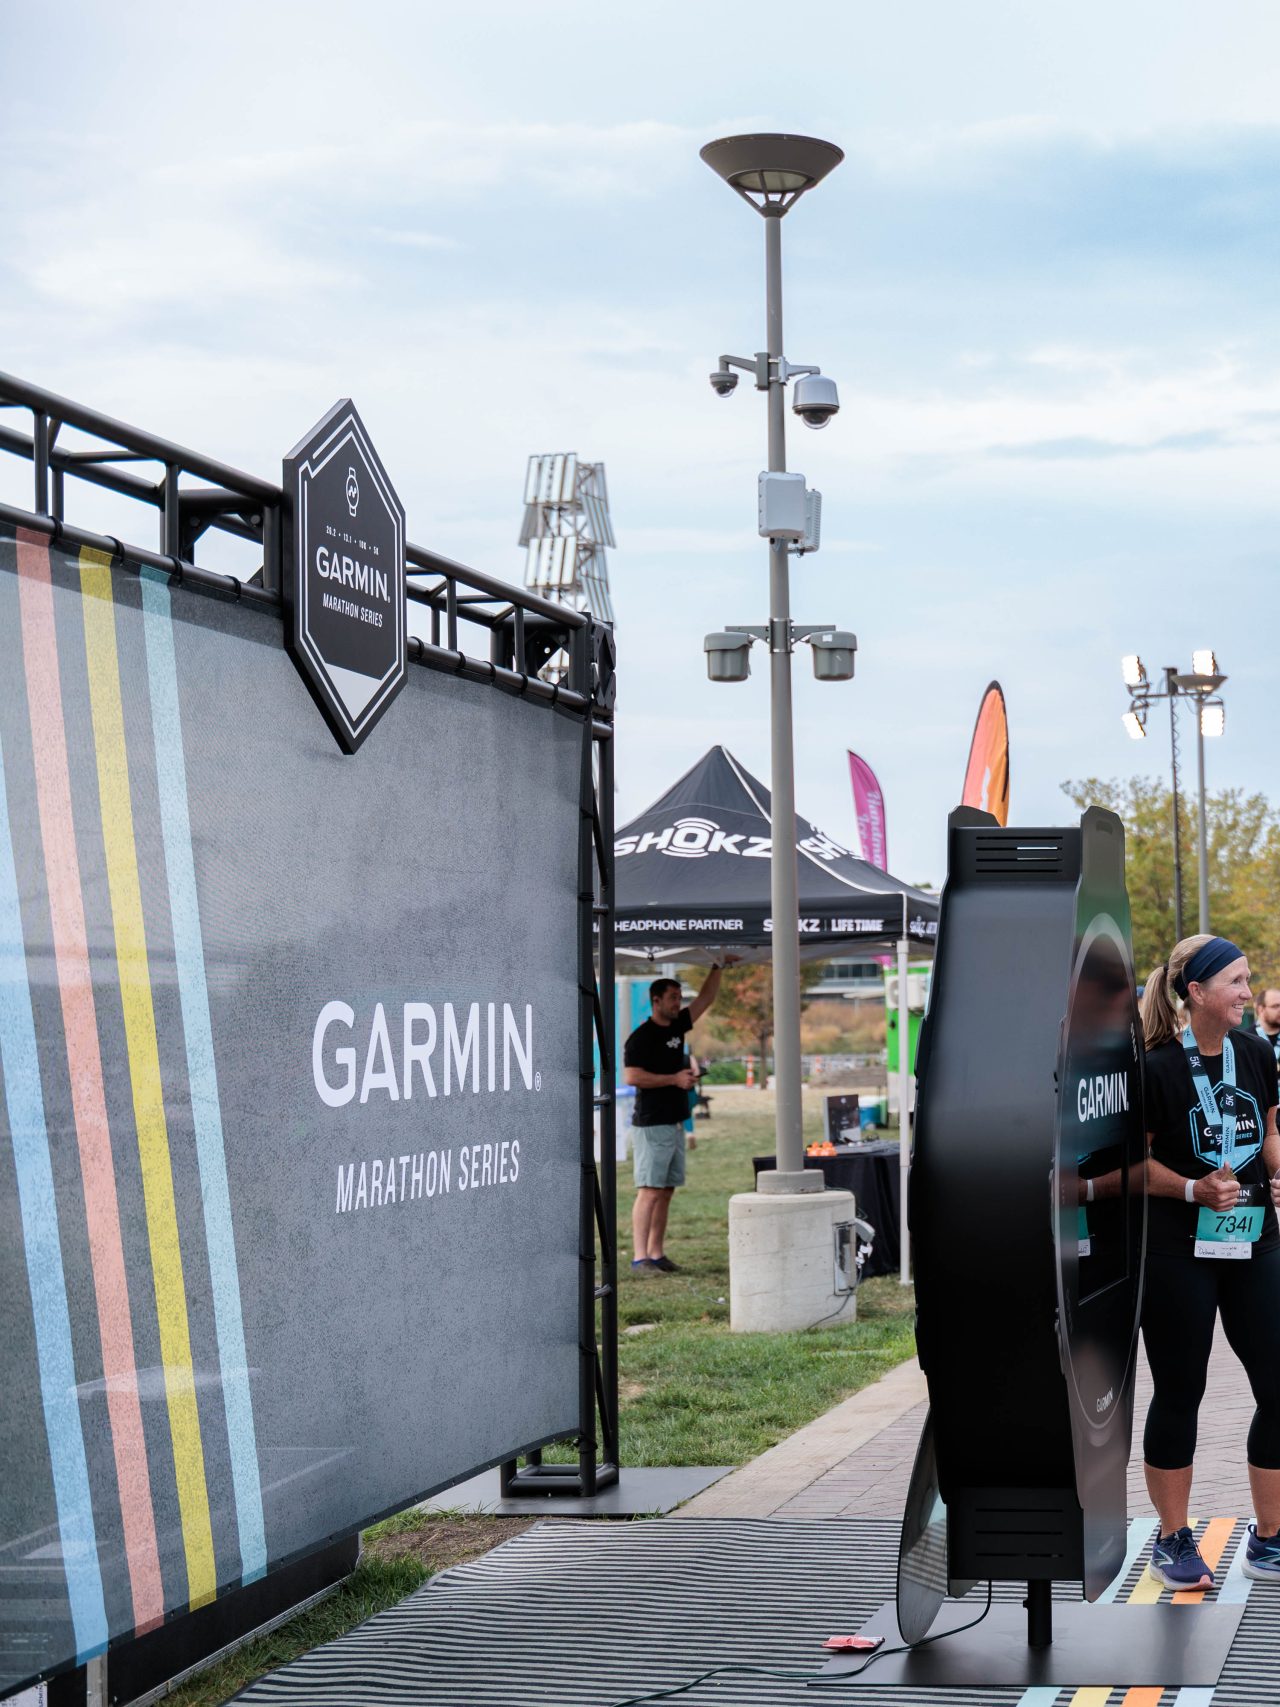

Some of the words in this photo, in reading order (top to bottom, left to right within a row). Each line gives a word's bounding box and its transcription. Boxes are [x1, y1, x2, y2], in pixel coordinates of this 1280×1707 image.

[322, 592, 359, 618] MARATHON
[360, 606, 383, 628] SERIES
[614, 919, 687, 932] HEADPHONE
[688, 918, 744, 931] PARTNER
[763, 918, 820, 932] SKZ
[1189, 1056, 1201, 1068] 5K
[1203, 1086, 1216, 1114] GARMIN
[1225, 1094, 1234, 1107] 5K
[336, 1149, 452, 1214] MARATHON
[458, 1139, 520, 1192] SERIES
[1215, 1215, 1253, 1233] 7341
